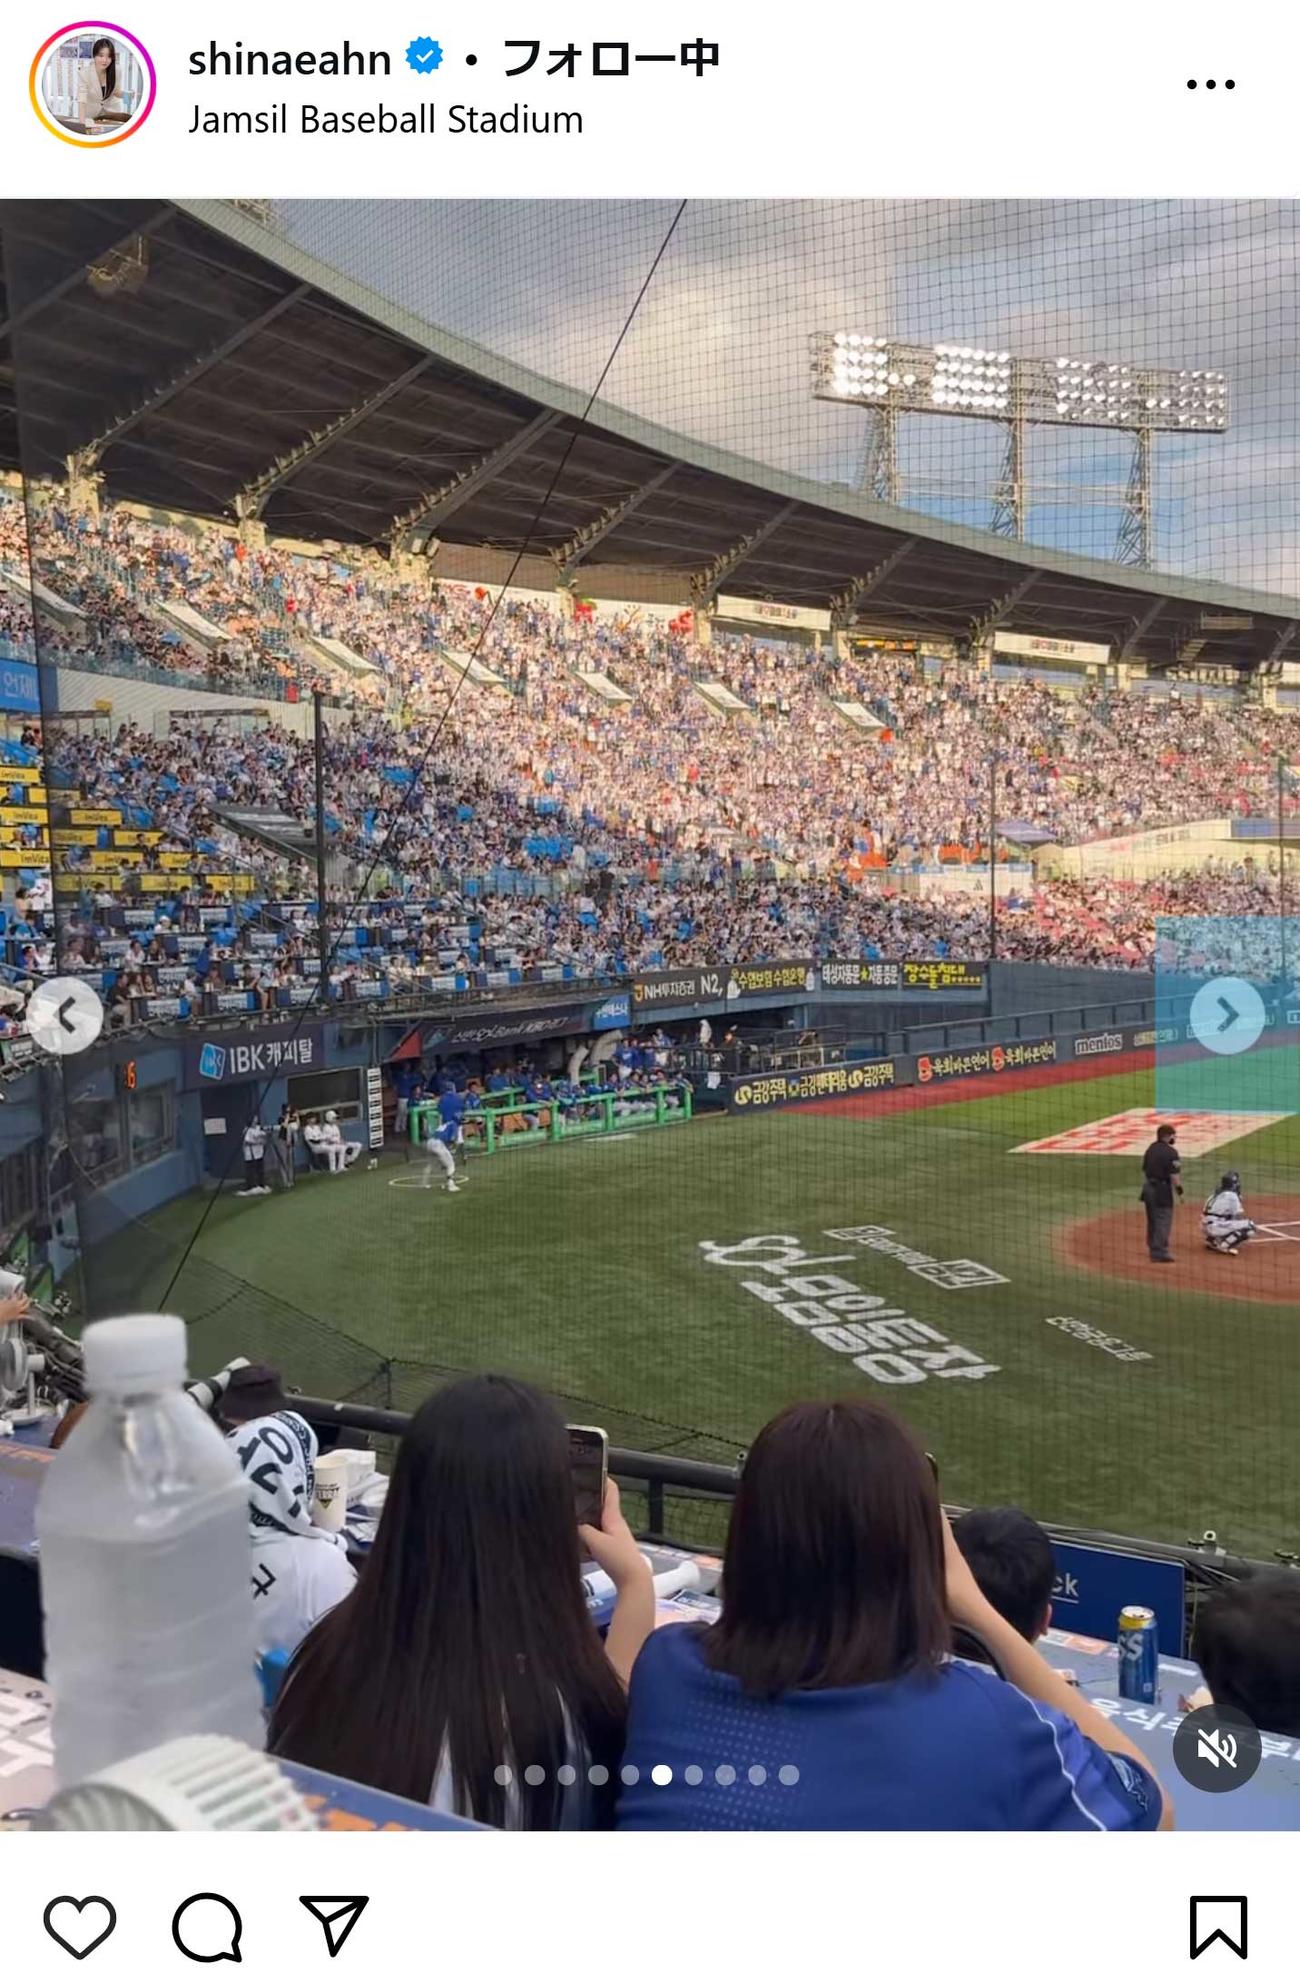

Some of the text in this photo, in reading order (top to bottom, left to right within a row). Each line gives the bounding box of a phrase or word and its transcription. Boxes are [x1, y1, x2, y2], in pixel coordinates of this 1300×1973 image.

[643, 980, 696, 999] NH투자증권
[1075, 1033, 1123, 1055] mentos
[740, 1273, 1002, 1385] 모임통장
